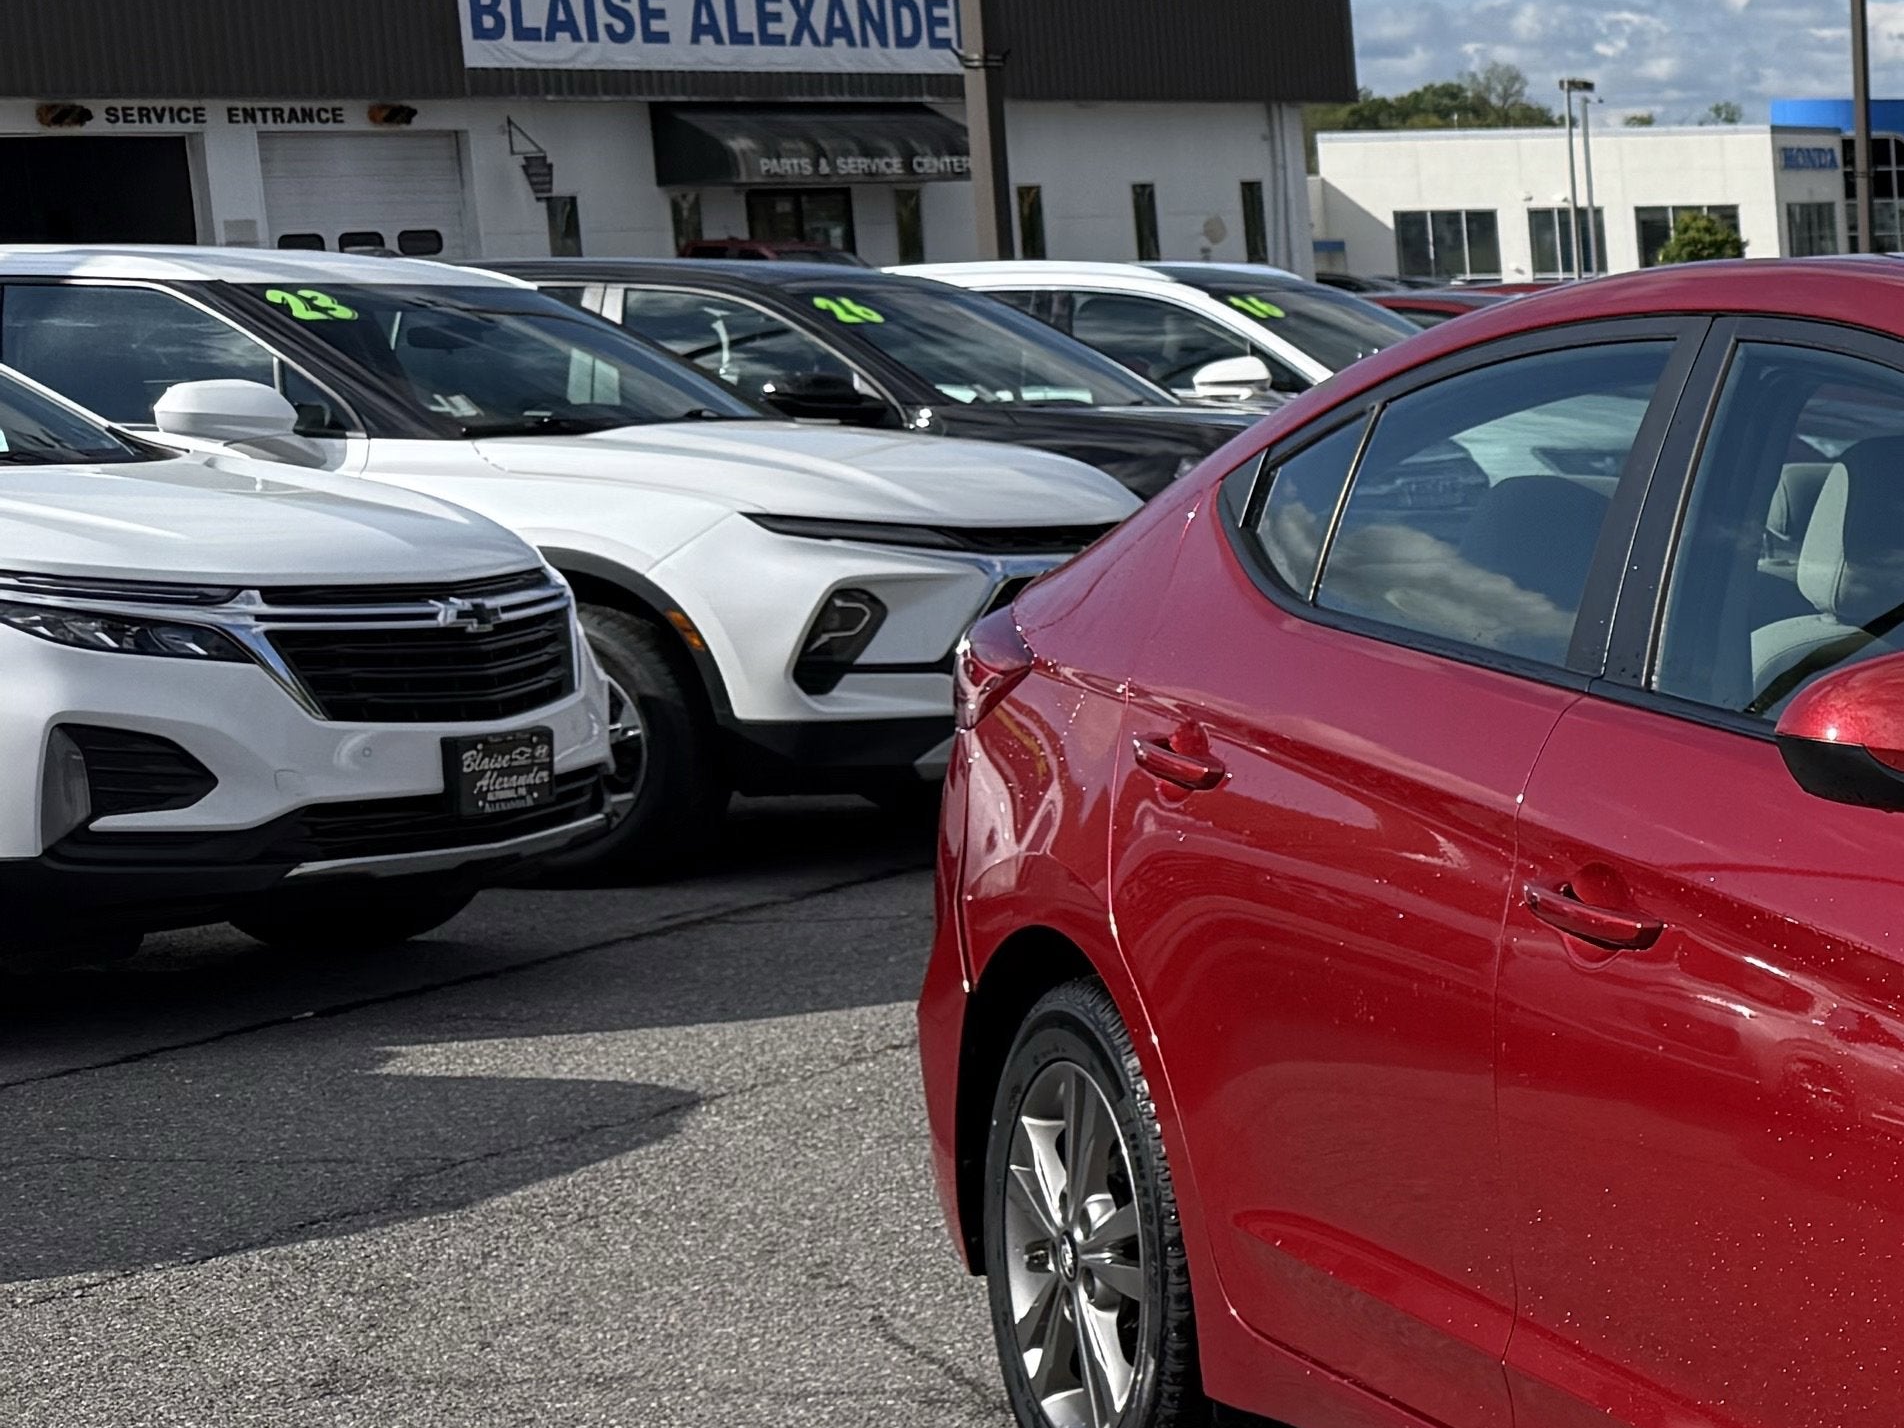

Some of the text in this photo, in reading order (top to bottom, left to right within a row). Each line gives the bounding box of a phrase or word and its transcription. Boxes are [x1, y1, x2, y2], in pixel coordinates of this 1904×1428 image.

[104, 106, 345, 124] SERVICE ENTRANCE
[760, 157, 813, 176] PARTS
[818, 157, 831, 175] &
[836, 155, 903, 174] SERVICE
[1781, 147, 1839, 169] HONDA
[265, 289, 359, 321] 23
[813, 296, 885, 323] 26
[462, 750, 511, 773] Blaise
[474, 766, 550, 794] Alexander
